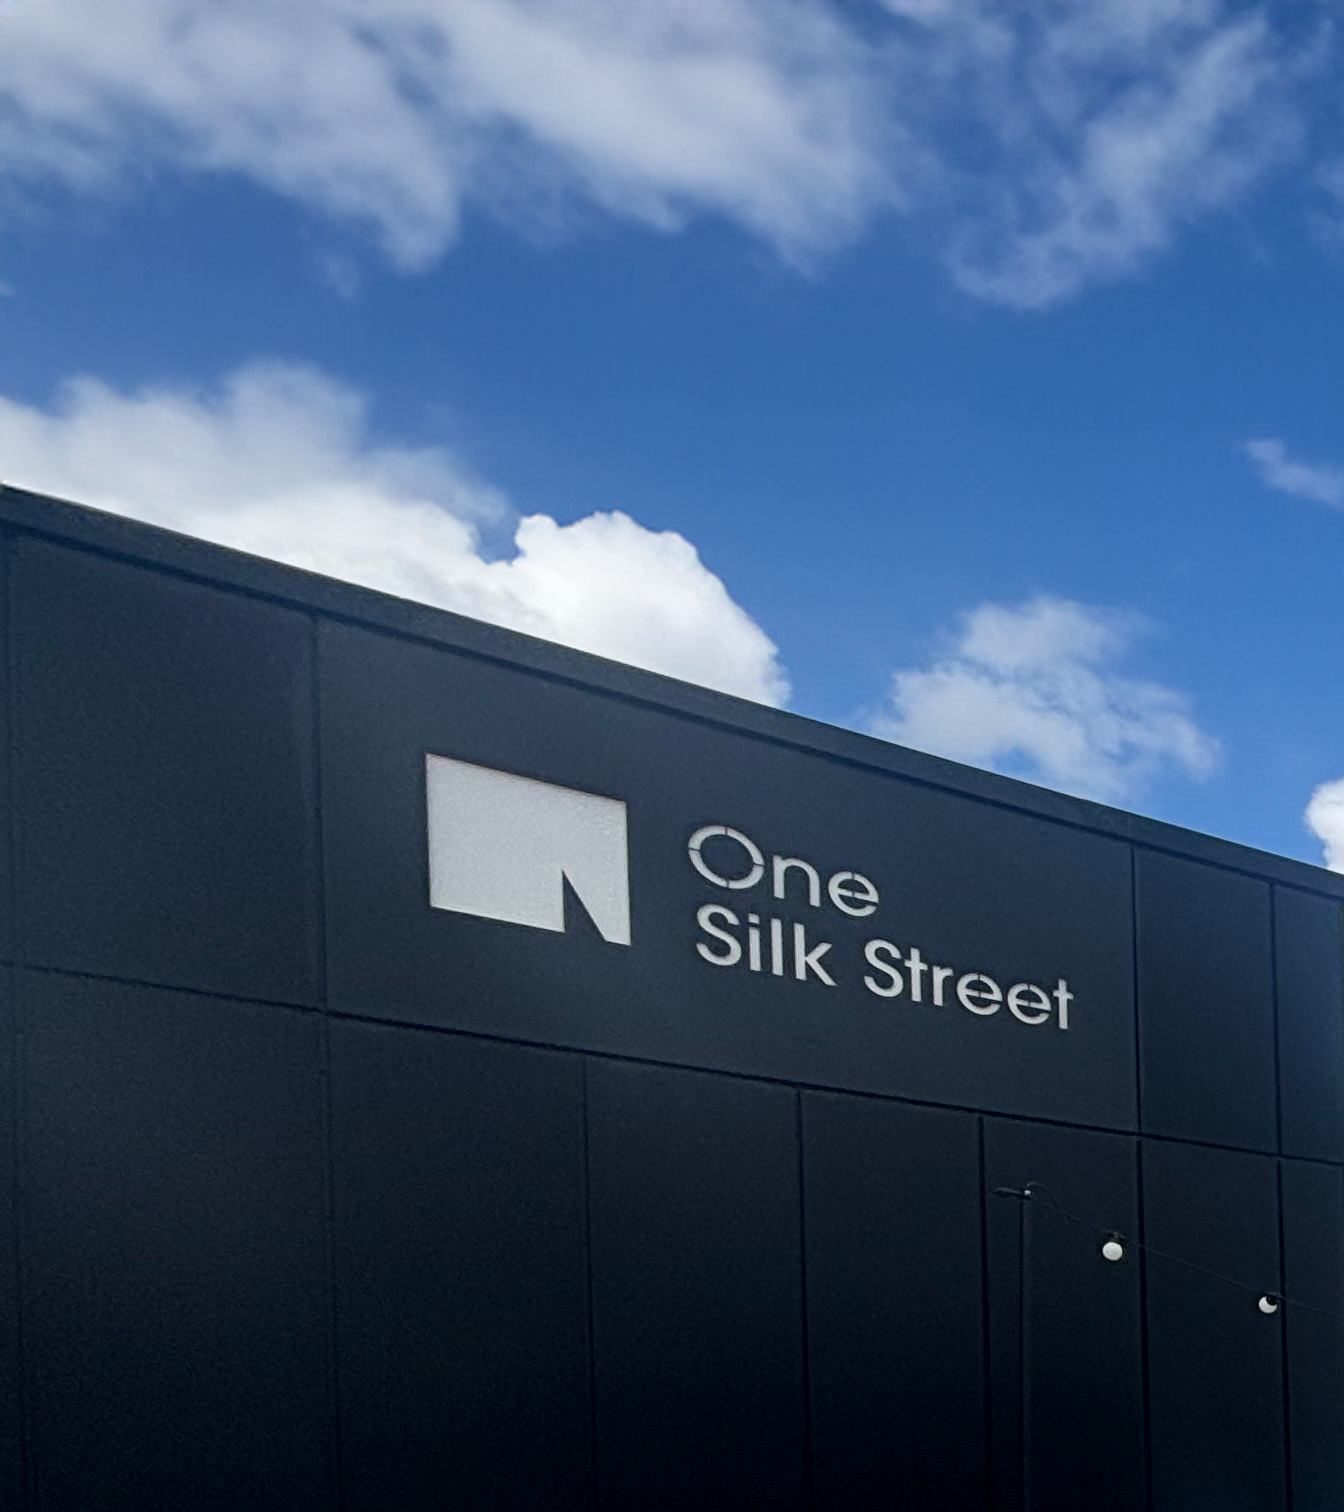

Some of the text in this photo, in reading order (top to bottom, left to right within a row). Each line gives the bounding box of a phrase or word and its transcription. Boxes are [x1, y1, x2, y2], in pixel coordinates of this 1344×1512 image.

[687, 825, 880, 918] One
[696, 904, 1075, 1030] Silk Street
